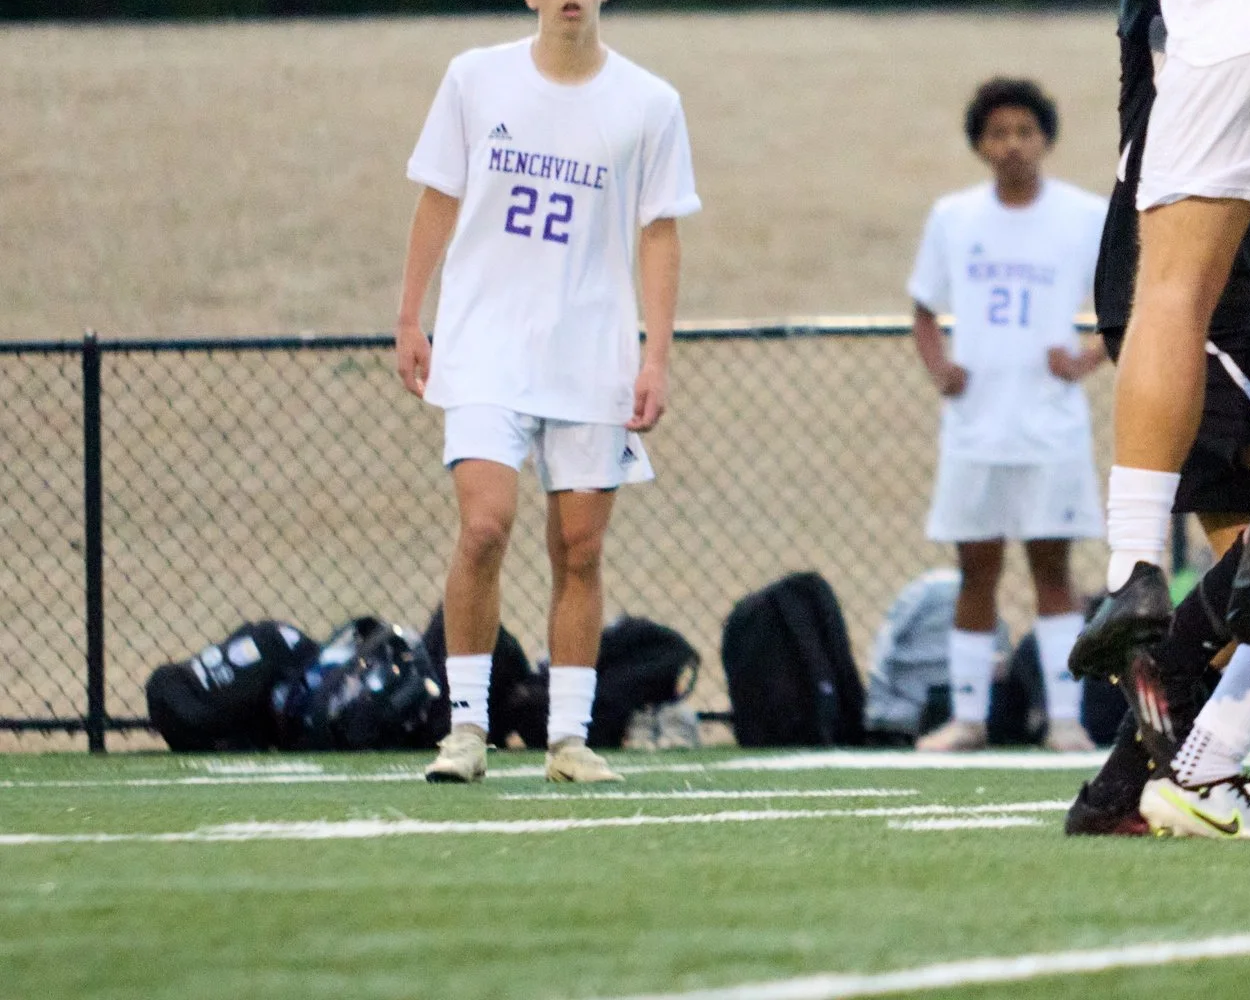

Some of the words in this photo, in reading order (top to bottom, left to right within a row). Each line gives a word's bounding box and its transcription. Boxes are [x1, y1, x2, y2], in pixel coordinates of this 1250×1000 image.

[488, 148, 608, 190] MENCHVILLE
[504, 185, 574, 244] 22
[988, 287, 1031, 328] 21
